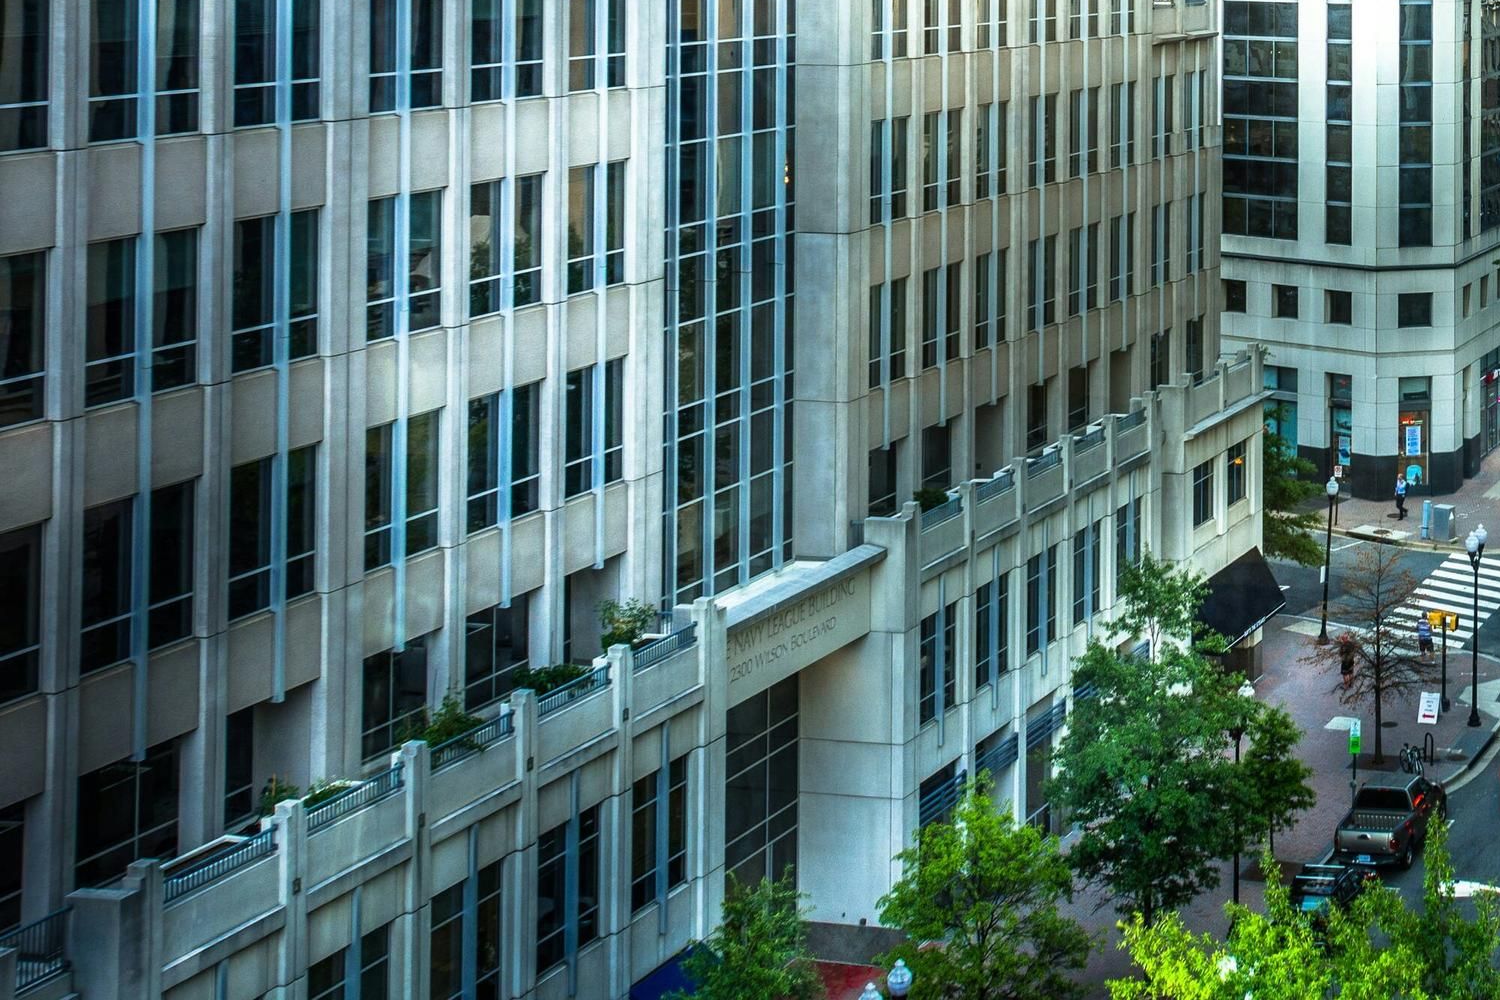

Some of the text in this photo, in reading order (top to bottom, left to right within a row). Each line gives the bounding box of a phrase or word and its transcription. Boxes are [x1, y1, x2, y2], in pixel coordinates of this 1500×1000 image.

[730, 658, 753, 682] 2300
[755, 644, 788, 668] WILSON
[791, 616, 837, 651] BOULEVARD
[734, 622, 764, 656] NAVY
[768, 604, 805, 637] LEAGUE
[809, 577, 855, 616] BUILDING
